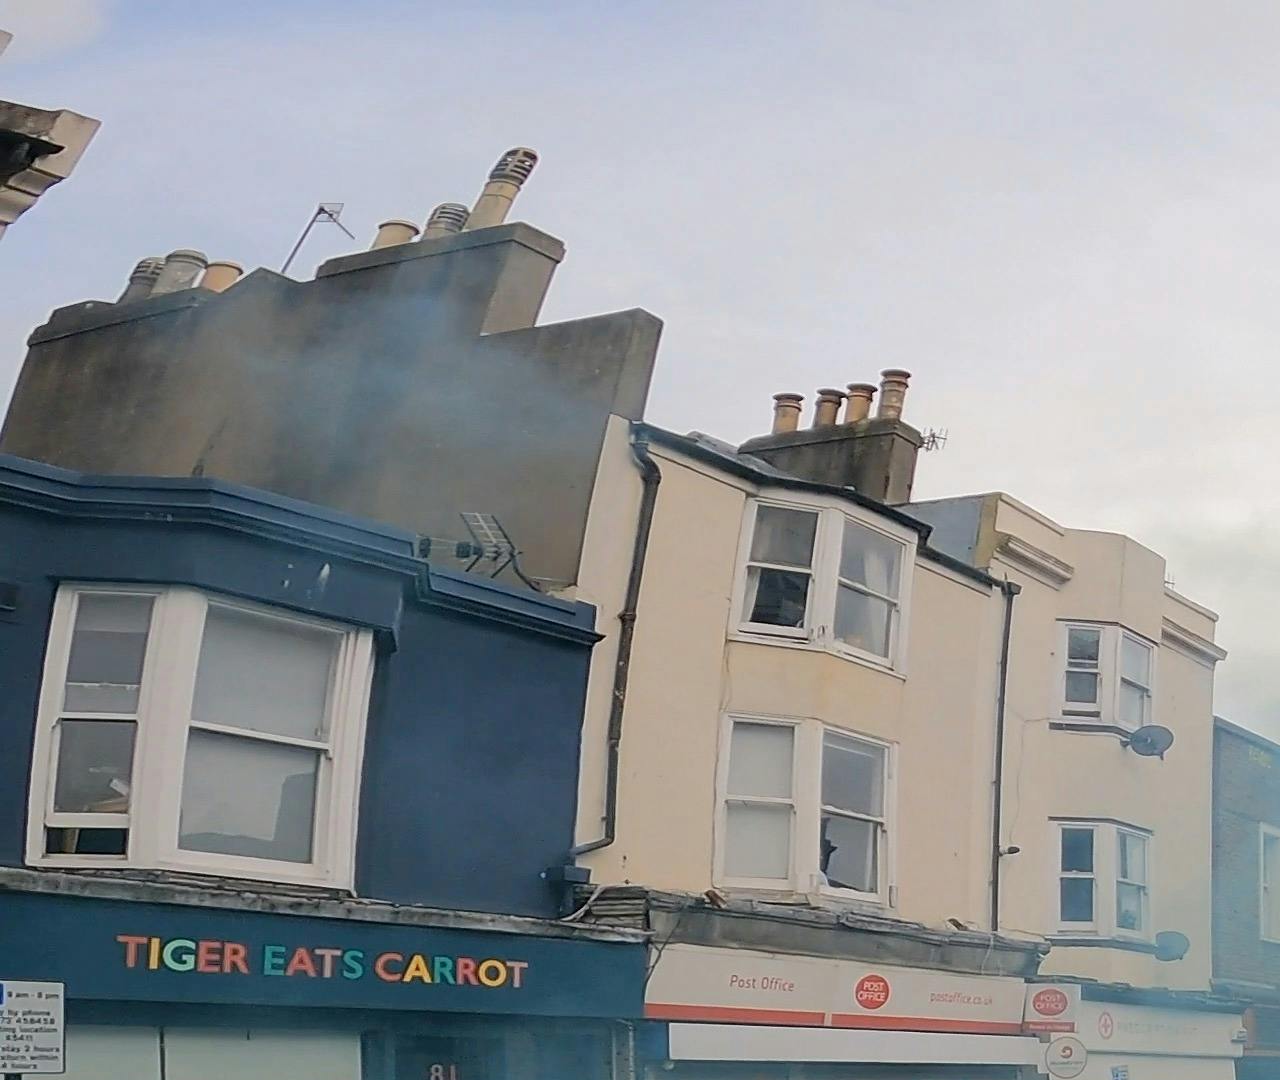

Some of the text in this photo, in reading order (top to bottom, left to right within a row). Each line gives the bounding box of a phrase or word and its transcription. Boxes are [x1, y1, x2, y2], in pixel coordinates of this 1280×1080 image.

[116, 934, 529, 989] TIGER EATS CARROT
[729, 974, 795, 992] Post Office
[863, 981, 885, 992] POST
[857, 991, 886, 1002] OFFICE
